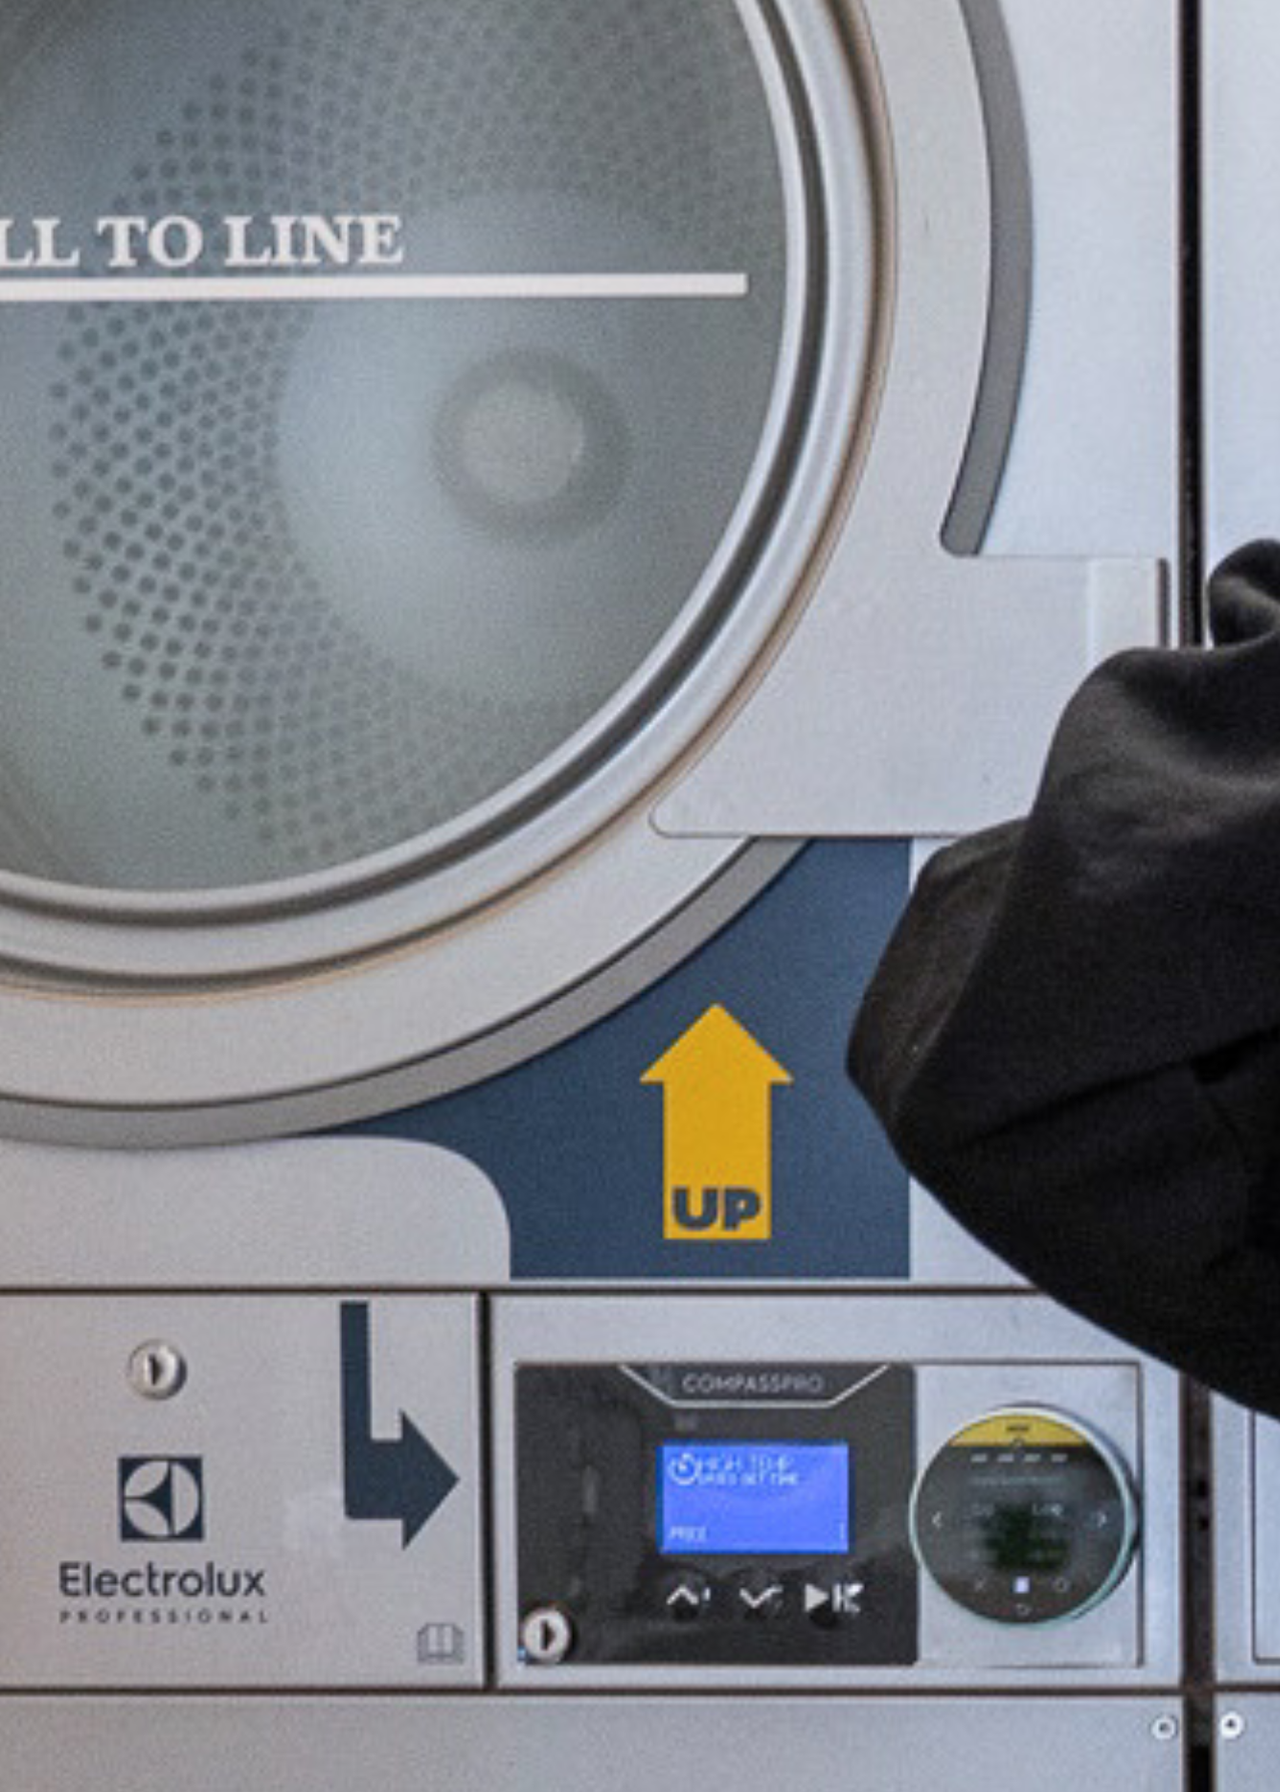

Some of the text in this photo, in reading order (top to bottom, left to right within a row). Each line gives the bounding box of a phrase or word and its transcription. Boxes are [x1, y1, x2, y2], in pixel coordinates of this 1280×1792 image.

[98, 214, 204, 268] TO
[223, 214, 404, 268] LINE
[672, 1185, 763, 1232] UP
[58, 1561, 267, 1598] Electrolux
[60, 1610, 269, 1624] PROFESSIONAL
